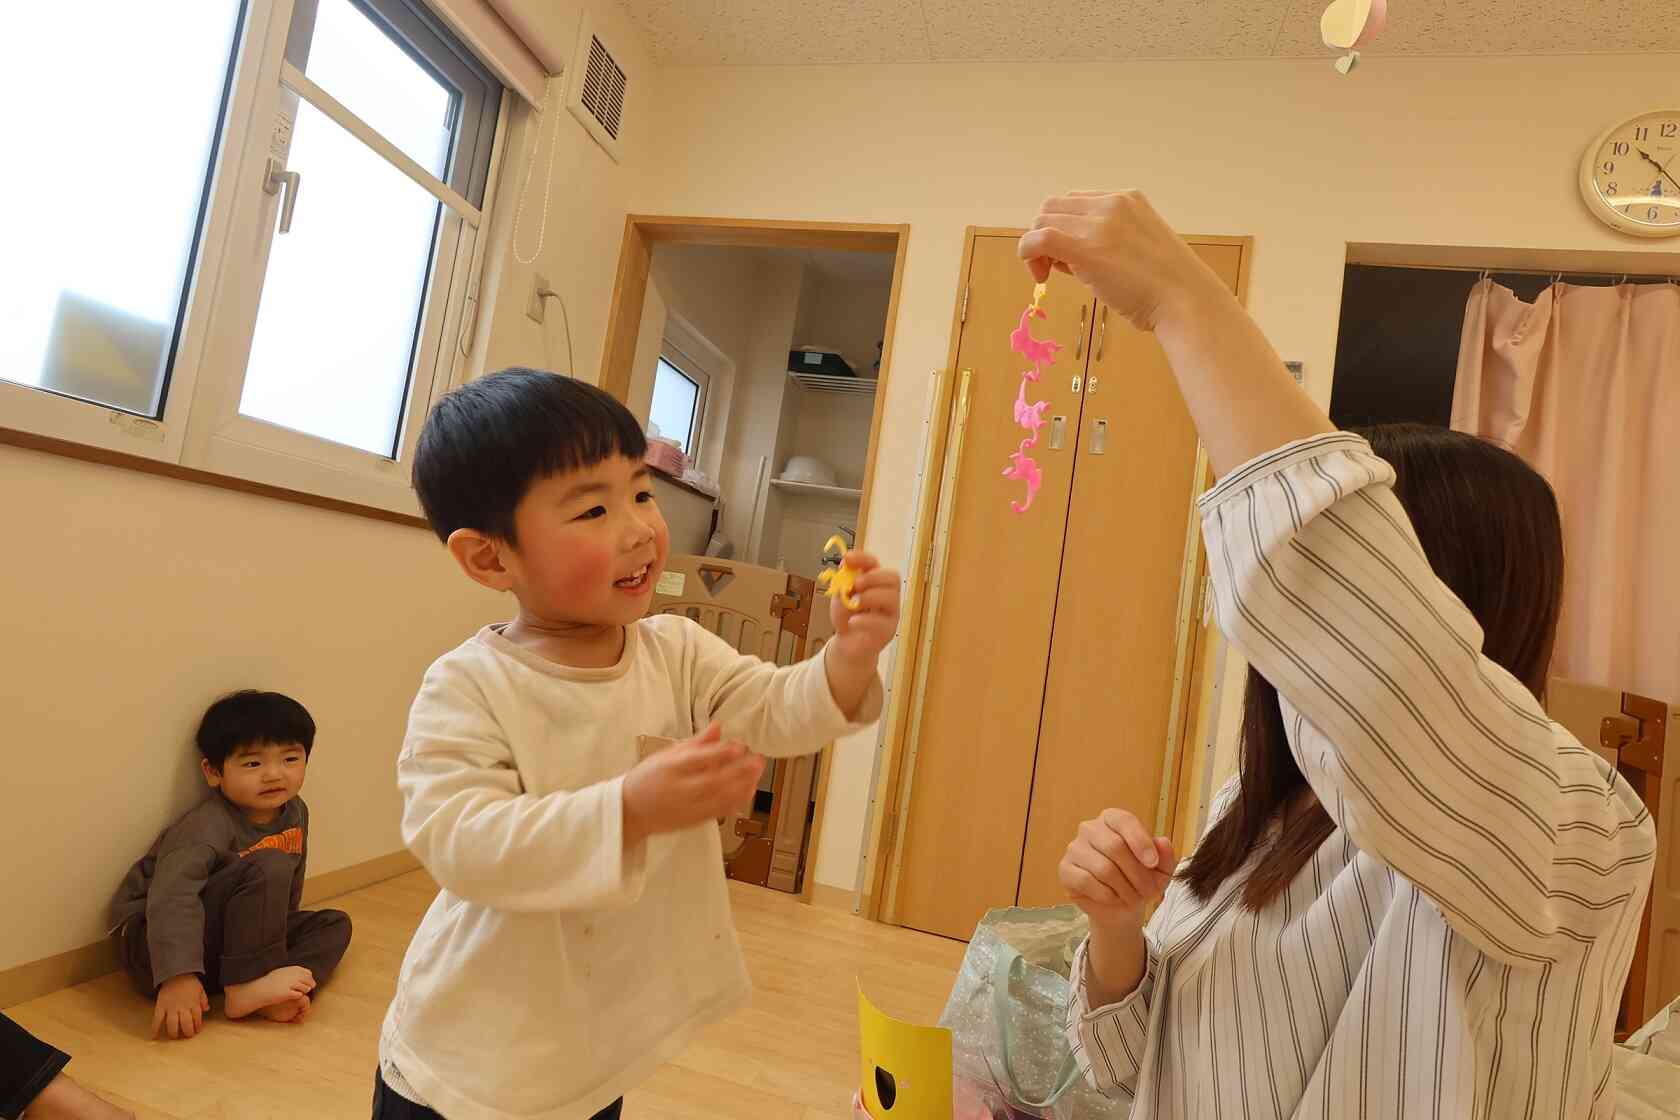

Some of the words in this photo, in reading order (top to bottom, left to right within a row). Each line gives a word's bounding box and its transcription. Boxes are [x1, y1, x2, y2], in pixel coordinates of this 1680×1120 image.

[1635, 127, 1649, 141] 11
[1660, 122, 1678, 138] 12
[1609, 141, 1630, 156] 10
[1602, 161, 1614, 175] 9
[1606, 182, 1617, 196] 8
[1647, 206, 1659, 220] 6
